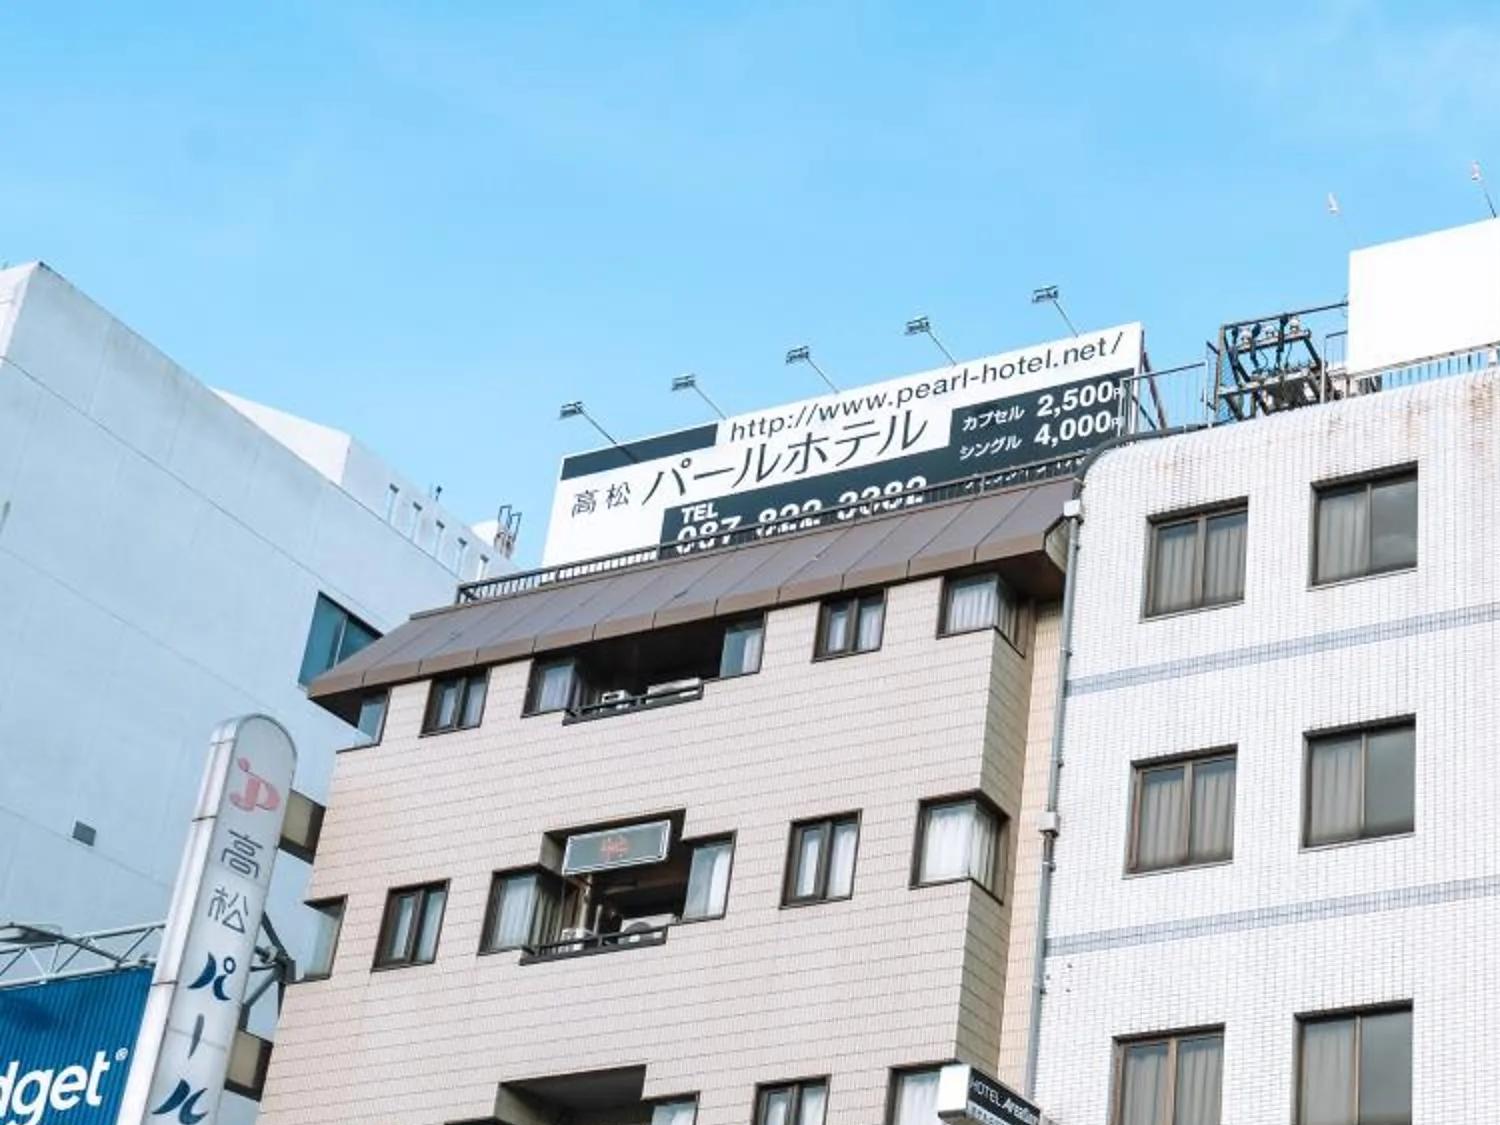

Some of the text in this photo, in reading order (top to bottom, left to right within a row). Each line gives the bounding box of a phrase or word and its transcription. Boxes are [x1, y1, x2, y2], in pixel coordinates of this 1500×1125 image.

[730, 332, 1123, 442] http://www.pearl-hotel.net/
[962, 405, 1025, 431] カプセル
[960, 435, 1022, 461] シングル
[571, 481, 631, 518] 高松
[642, 410, 928, 506] パールホテル
[681, 503, 718, 524] TEL
